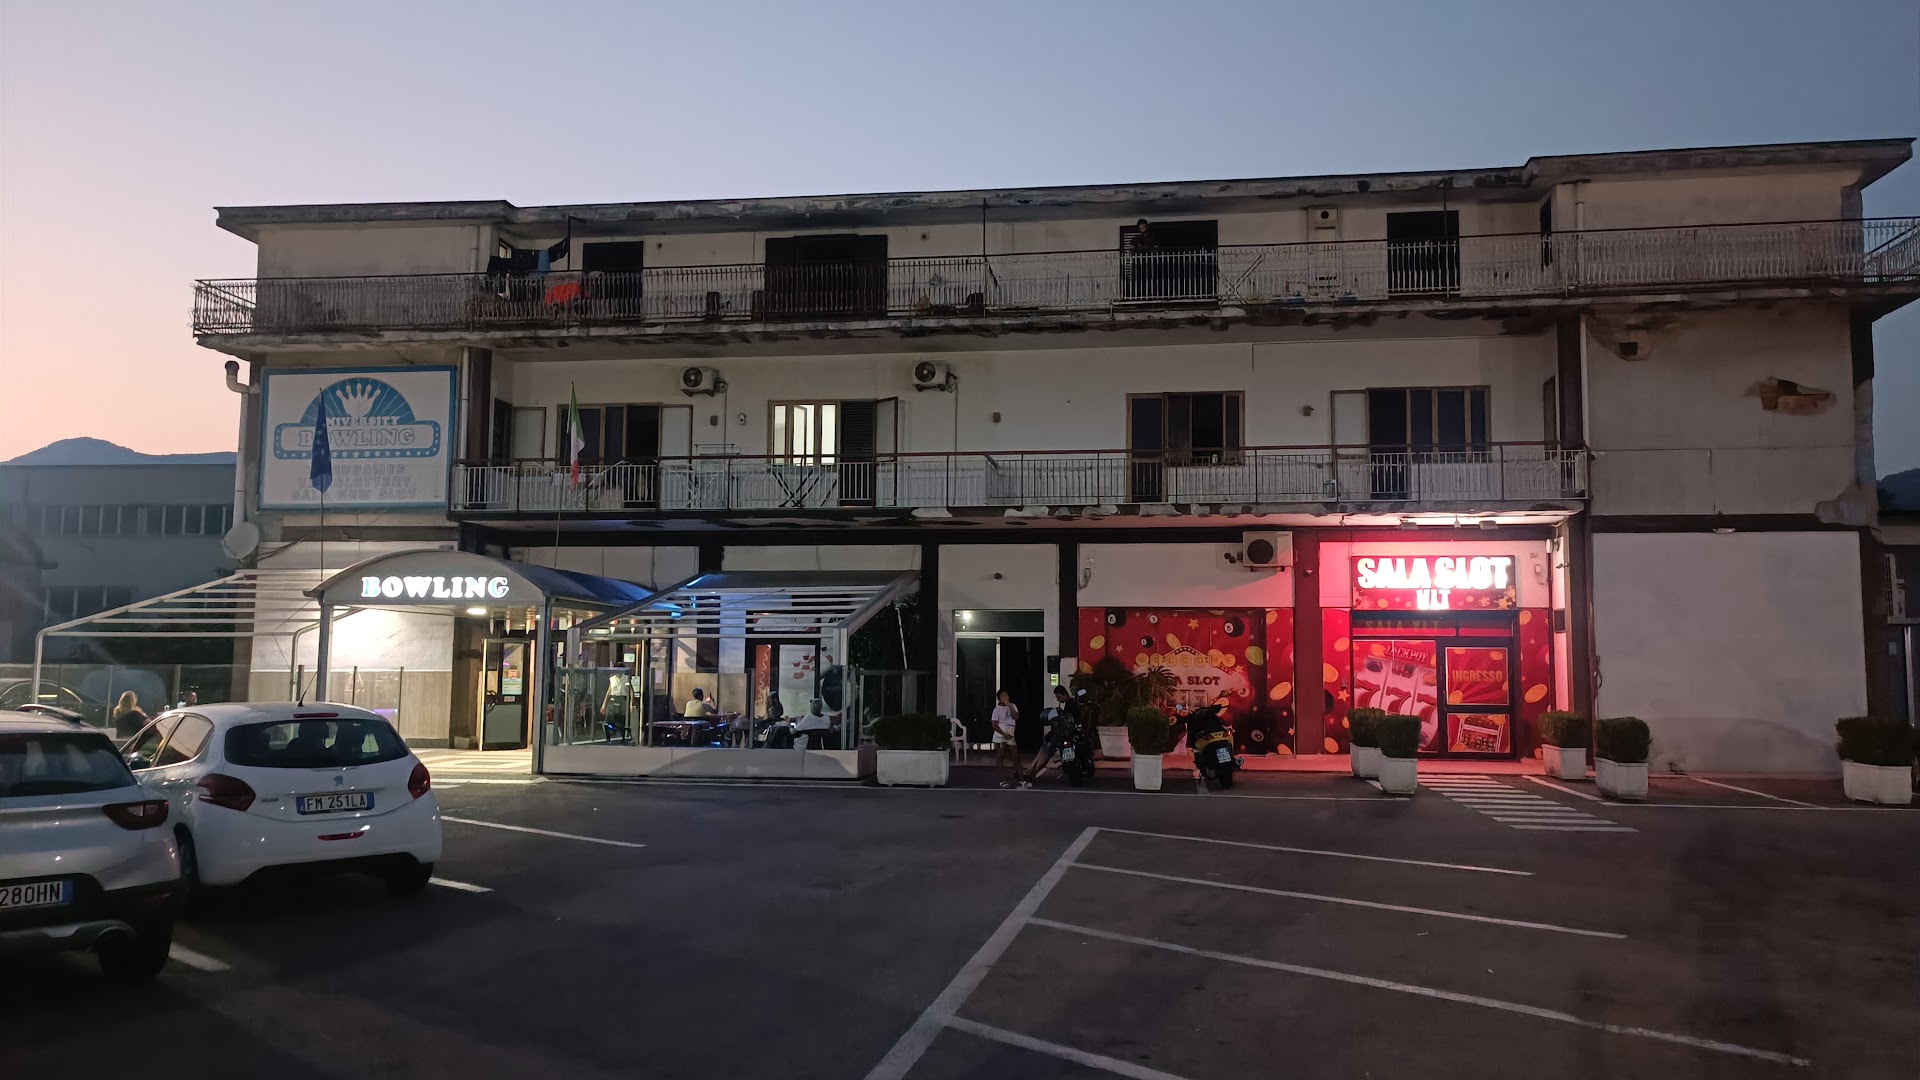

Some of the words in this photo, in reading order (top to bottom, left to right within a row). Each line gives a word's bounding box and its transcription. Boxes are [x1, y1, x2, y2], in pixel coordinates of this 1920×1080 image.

[298, 427, 416, 447] BWLING
[1357, 557, 1432, 589] SALA
[1433, 556, 1511, 590] SLOT
[361, 576, 509, 598] BOWLING
[1138, 654, 1233, 665] WELCOME
[1187, 675, 1221, 686] SLOT
[1452, 669, 1502, 683] INGRESSO
[1386, 686, 1411, 715] 7
[306, 797, 323, 811] FM
[328, 794, 366, 809] 251LA
